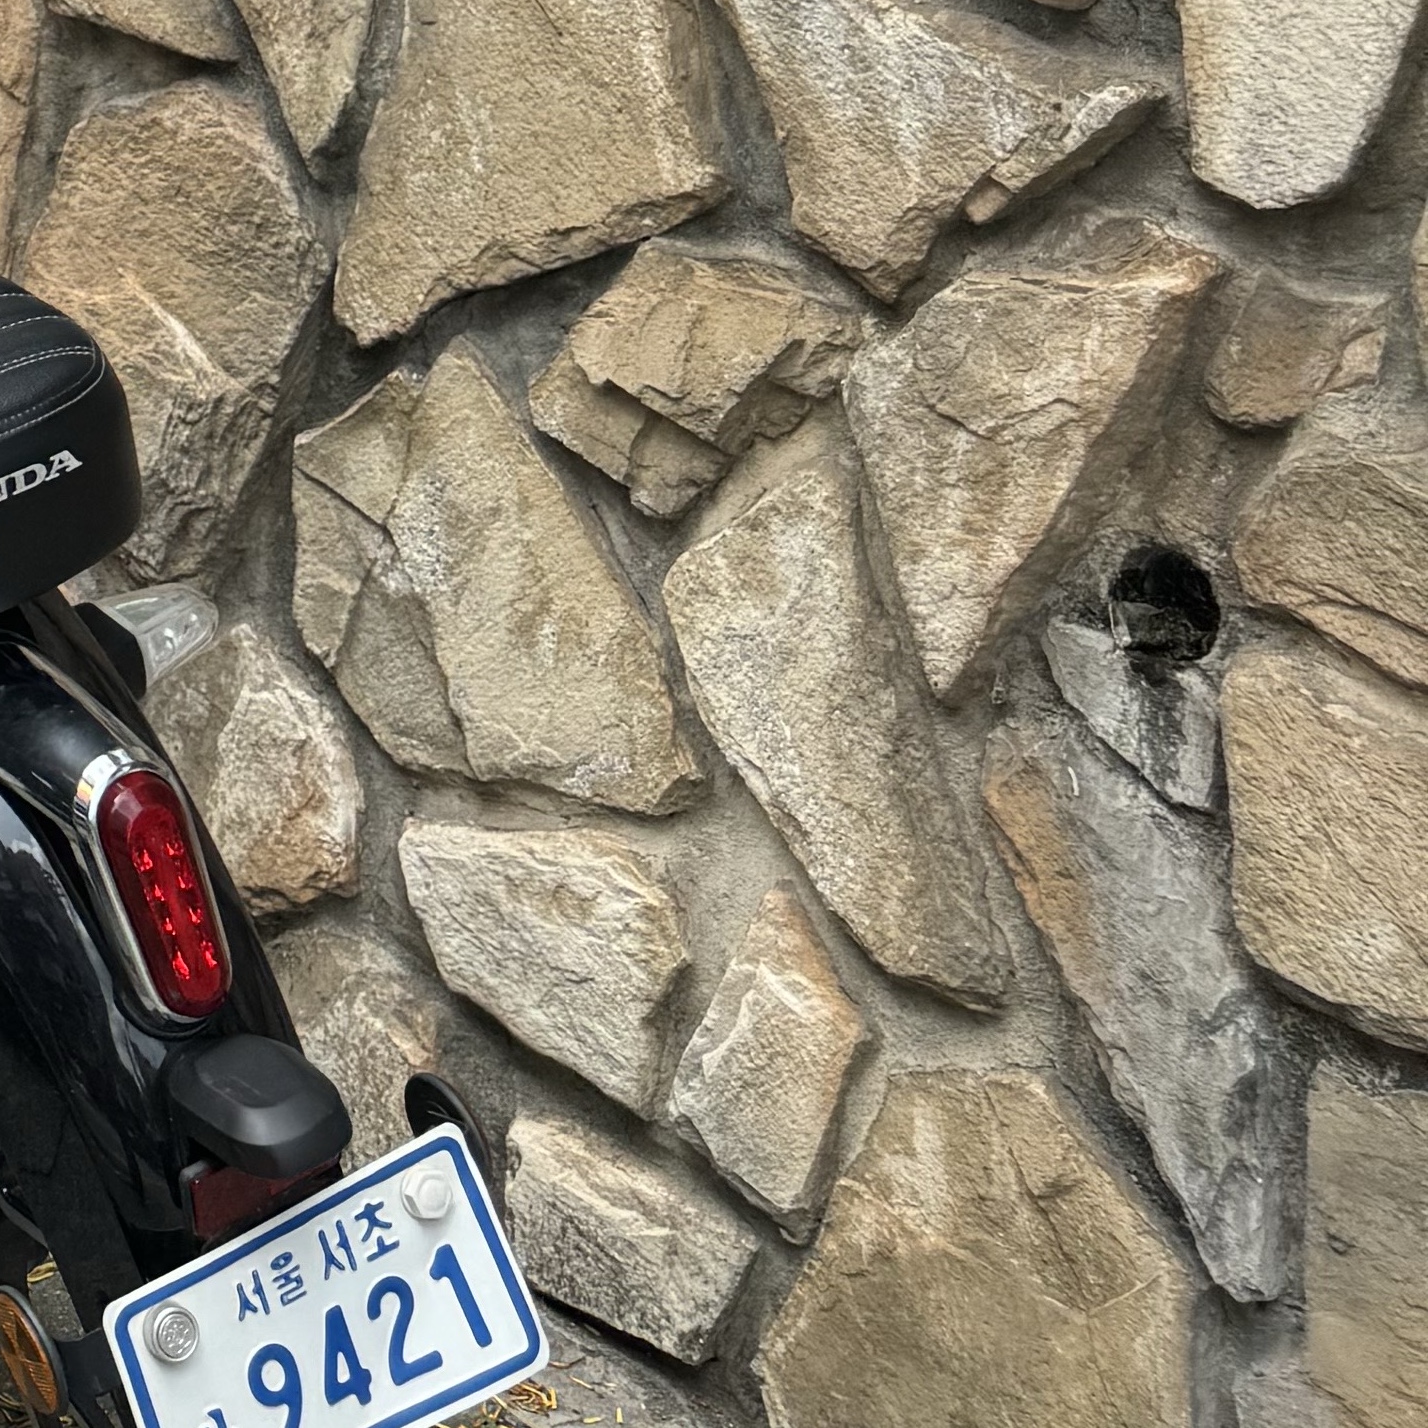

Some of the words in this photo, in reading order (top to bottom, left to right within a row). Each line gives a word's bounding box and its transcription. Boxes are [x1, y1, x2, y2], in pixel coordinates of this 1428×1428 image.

[235, 1251, 308, 1322] 서울
[318, 1200, 401, 1281] 서초
[246, 1242, 493, 1428] 9421
